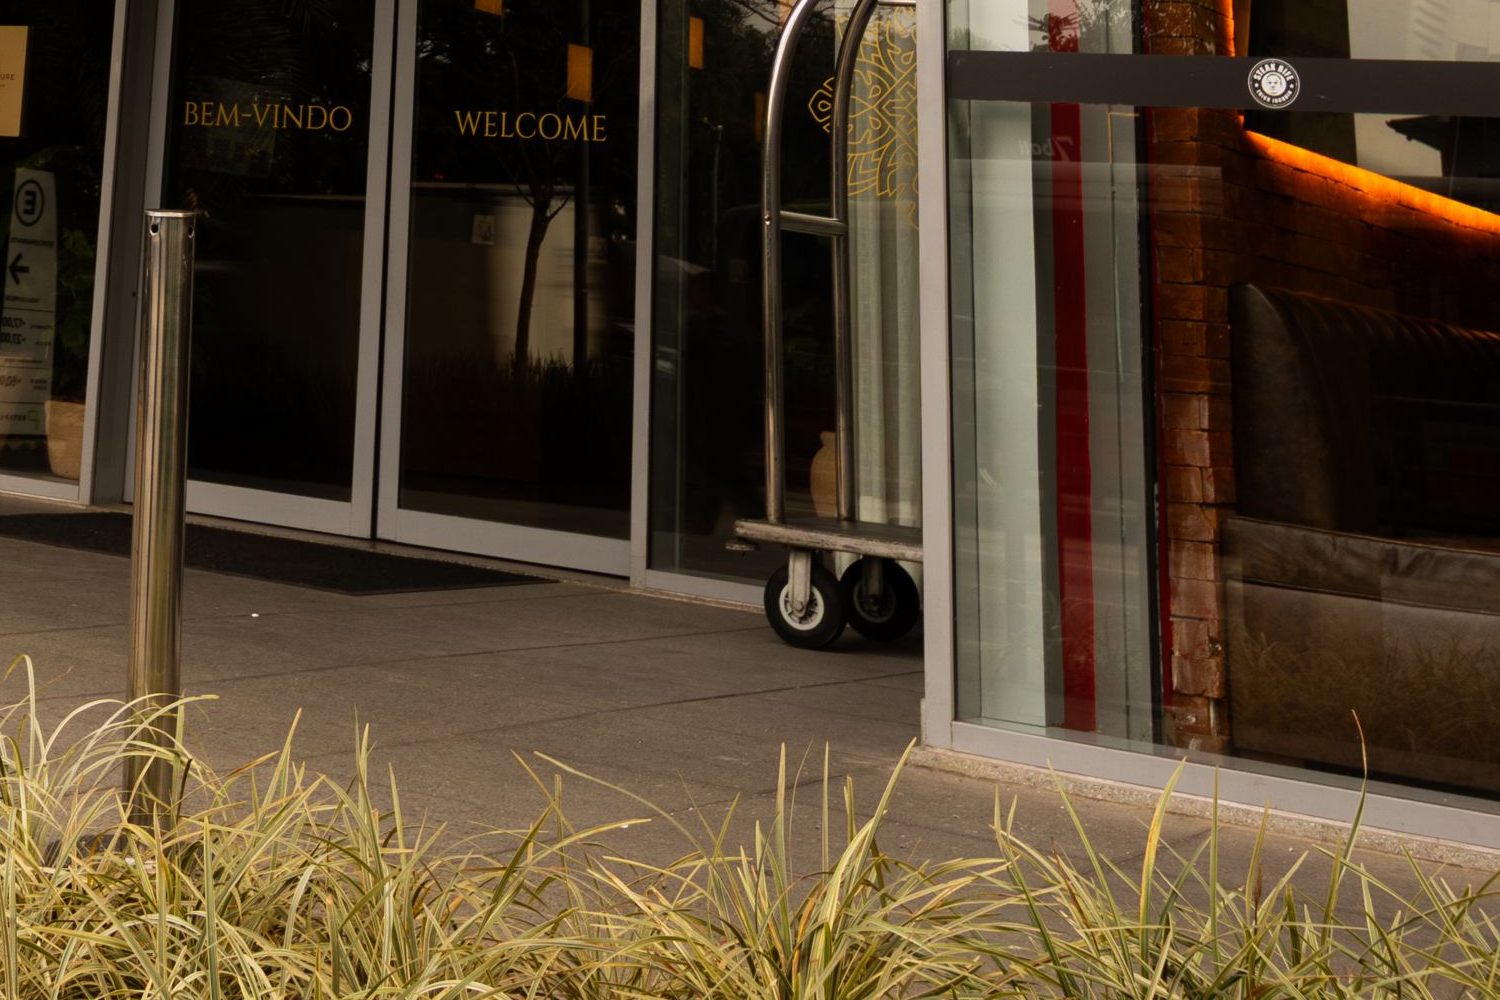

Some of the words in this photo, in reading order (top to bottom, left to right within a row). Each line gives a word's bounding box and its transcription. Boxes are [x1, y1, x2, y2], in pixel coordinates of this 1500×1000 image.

[1253, 63, 1276, 81] STEAK
[183, 101, 352, 131] BEM-VINDO
[454, 110, 607, 142] WELCOME
